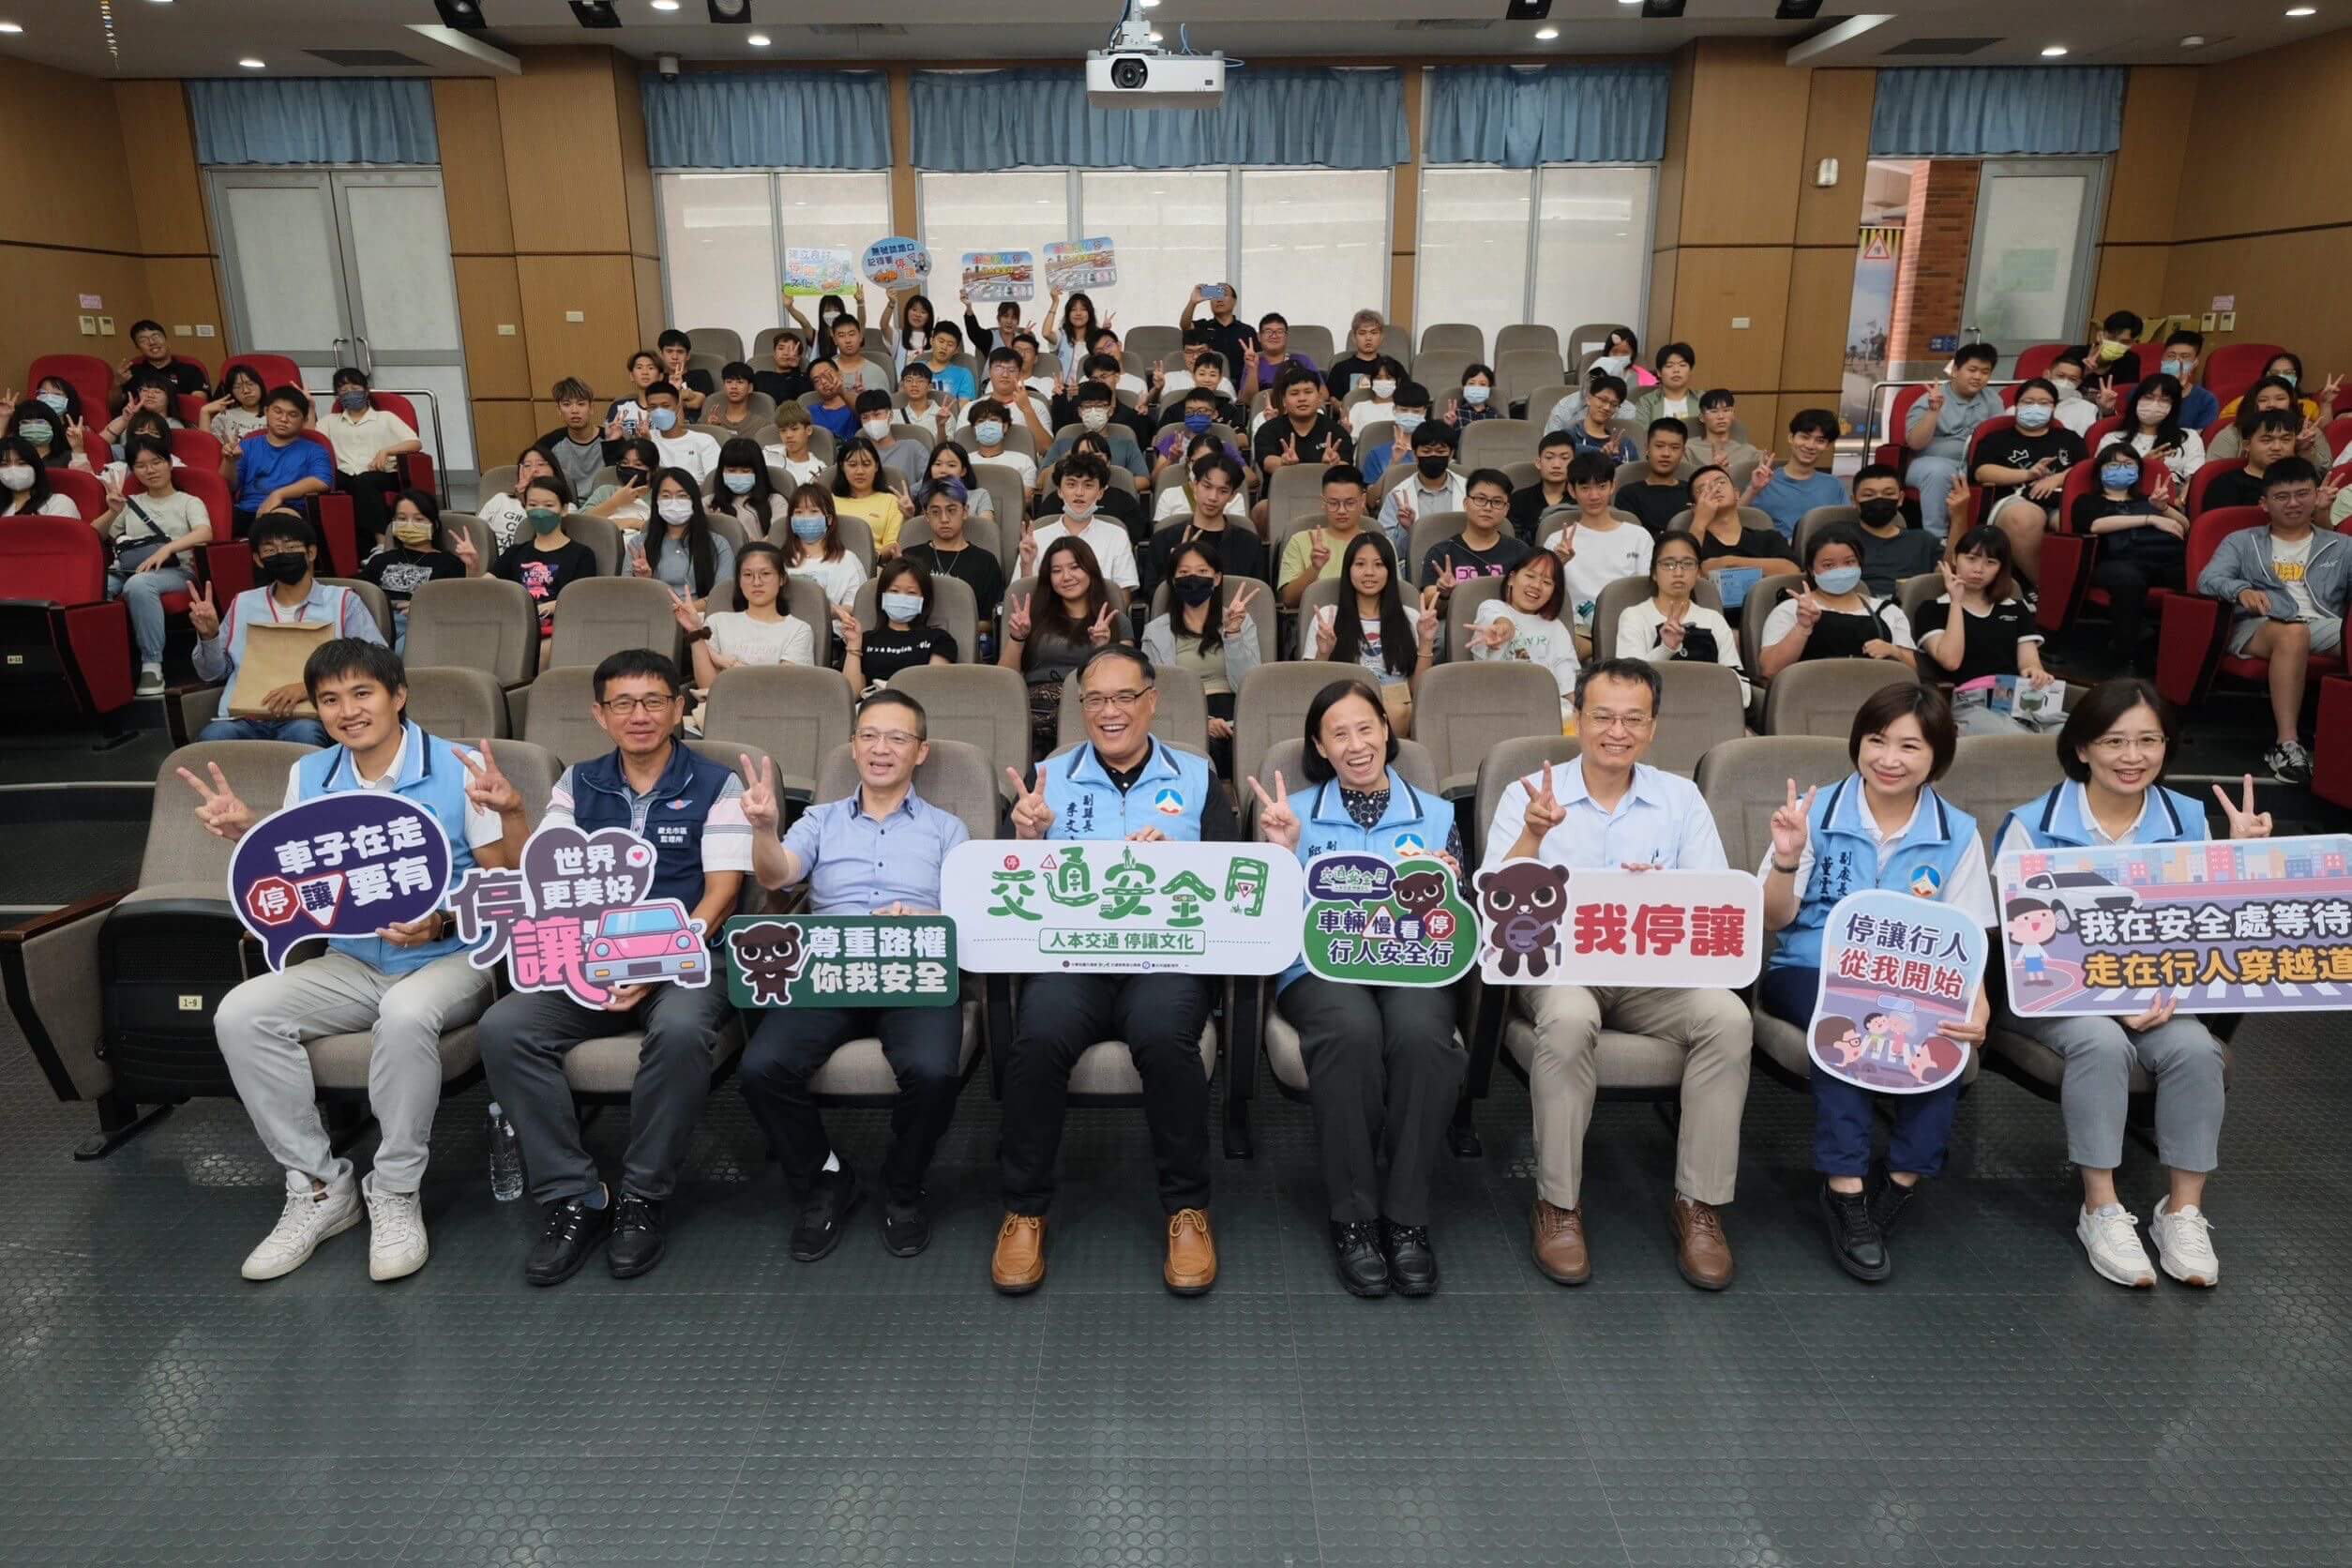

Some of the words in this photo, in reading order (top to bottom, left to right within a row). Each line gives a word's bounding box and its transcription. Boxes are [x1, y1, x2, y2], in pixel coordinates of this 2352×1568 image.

[275, 816, 427, 874] 車子在走
[553, 844, 617, 876] 世界
[541, 875, 636, 910] 更美好
[988, 845, 1270, 928] 交通安全月
[807, 926, 947, 958] 尊重路權
[1575, 903, 1746, 957] 我停讓
[1846, 913, 1968, 962] 停讓行人
[2080, 901, 2352, 943] 我在安全處等待
[1329, 940, 1454, 965] 行人安全行
[1839, 948, 1964, 997] 從我開始
[2085, 947, 2352, 987] 走在行人穿越道
[809, 961, 948, 993] 你我安全
